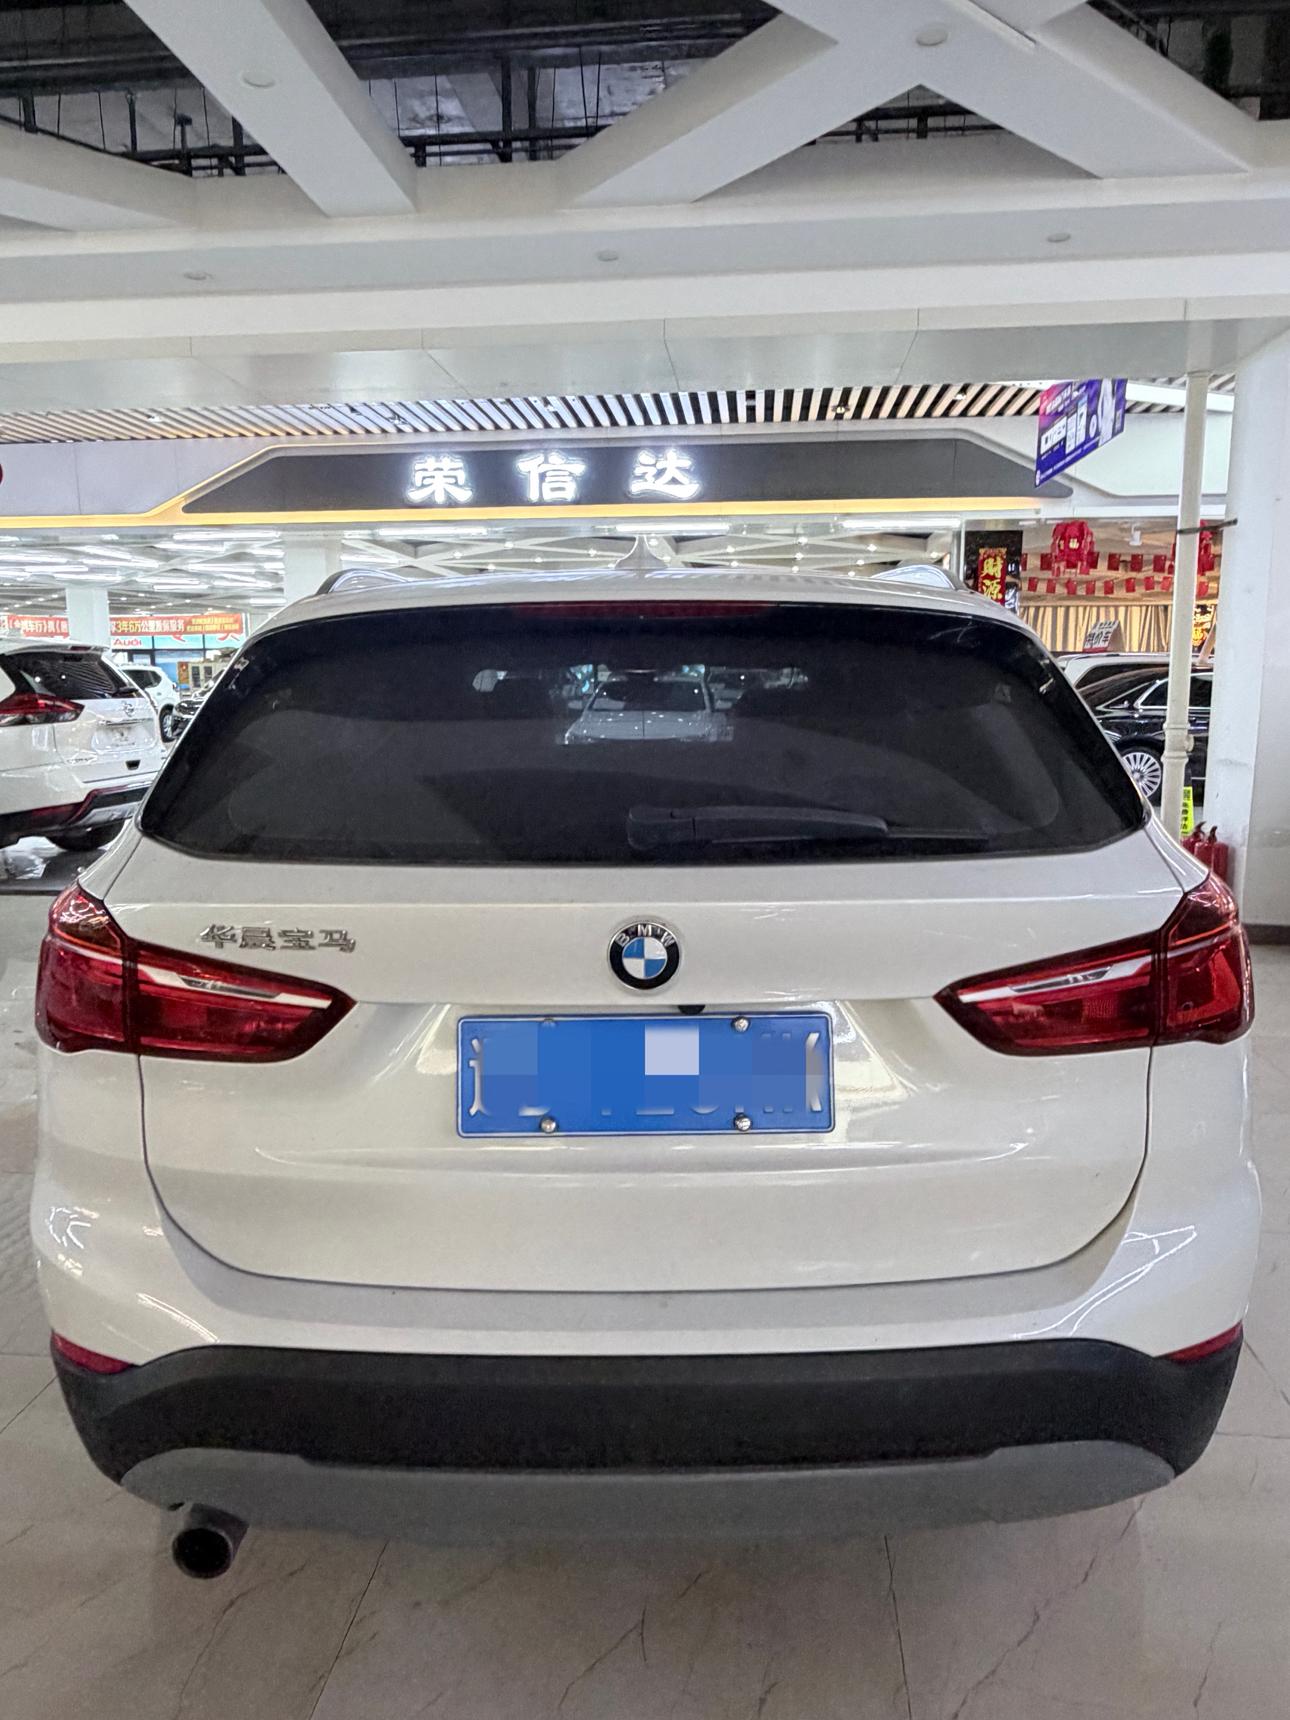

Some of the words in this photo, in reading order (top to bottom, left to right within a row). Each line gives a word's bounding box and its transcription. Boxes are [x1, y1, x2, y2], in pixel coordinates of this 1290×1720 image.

[407, 449, 701, 503] 荣信达
[200, 923, 356, 953] 华晨宝马
[615, 924, 675, 948] BMW
